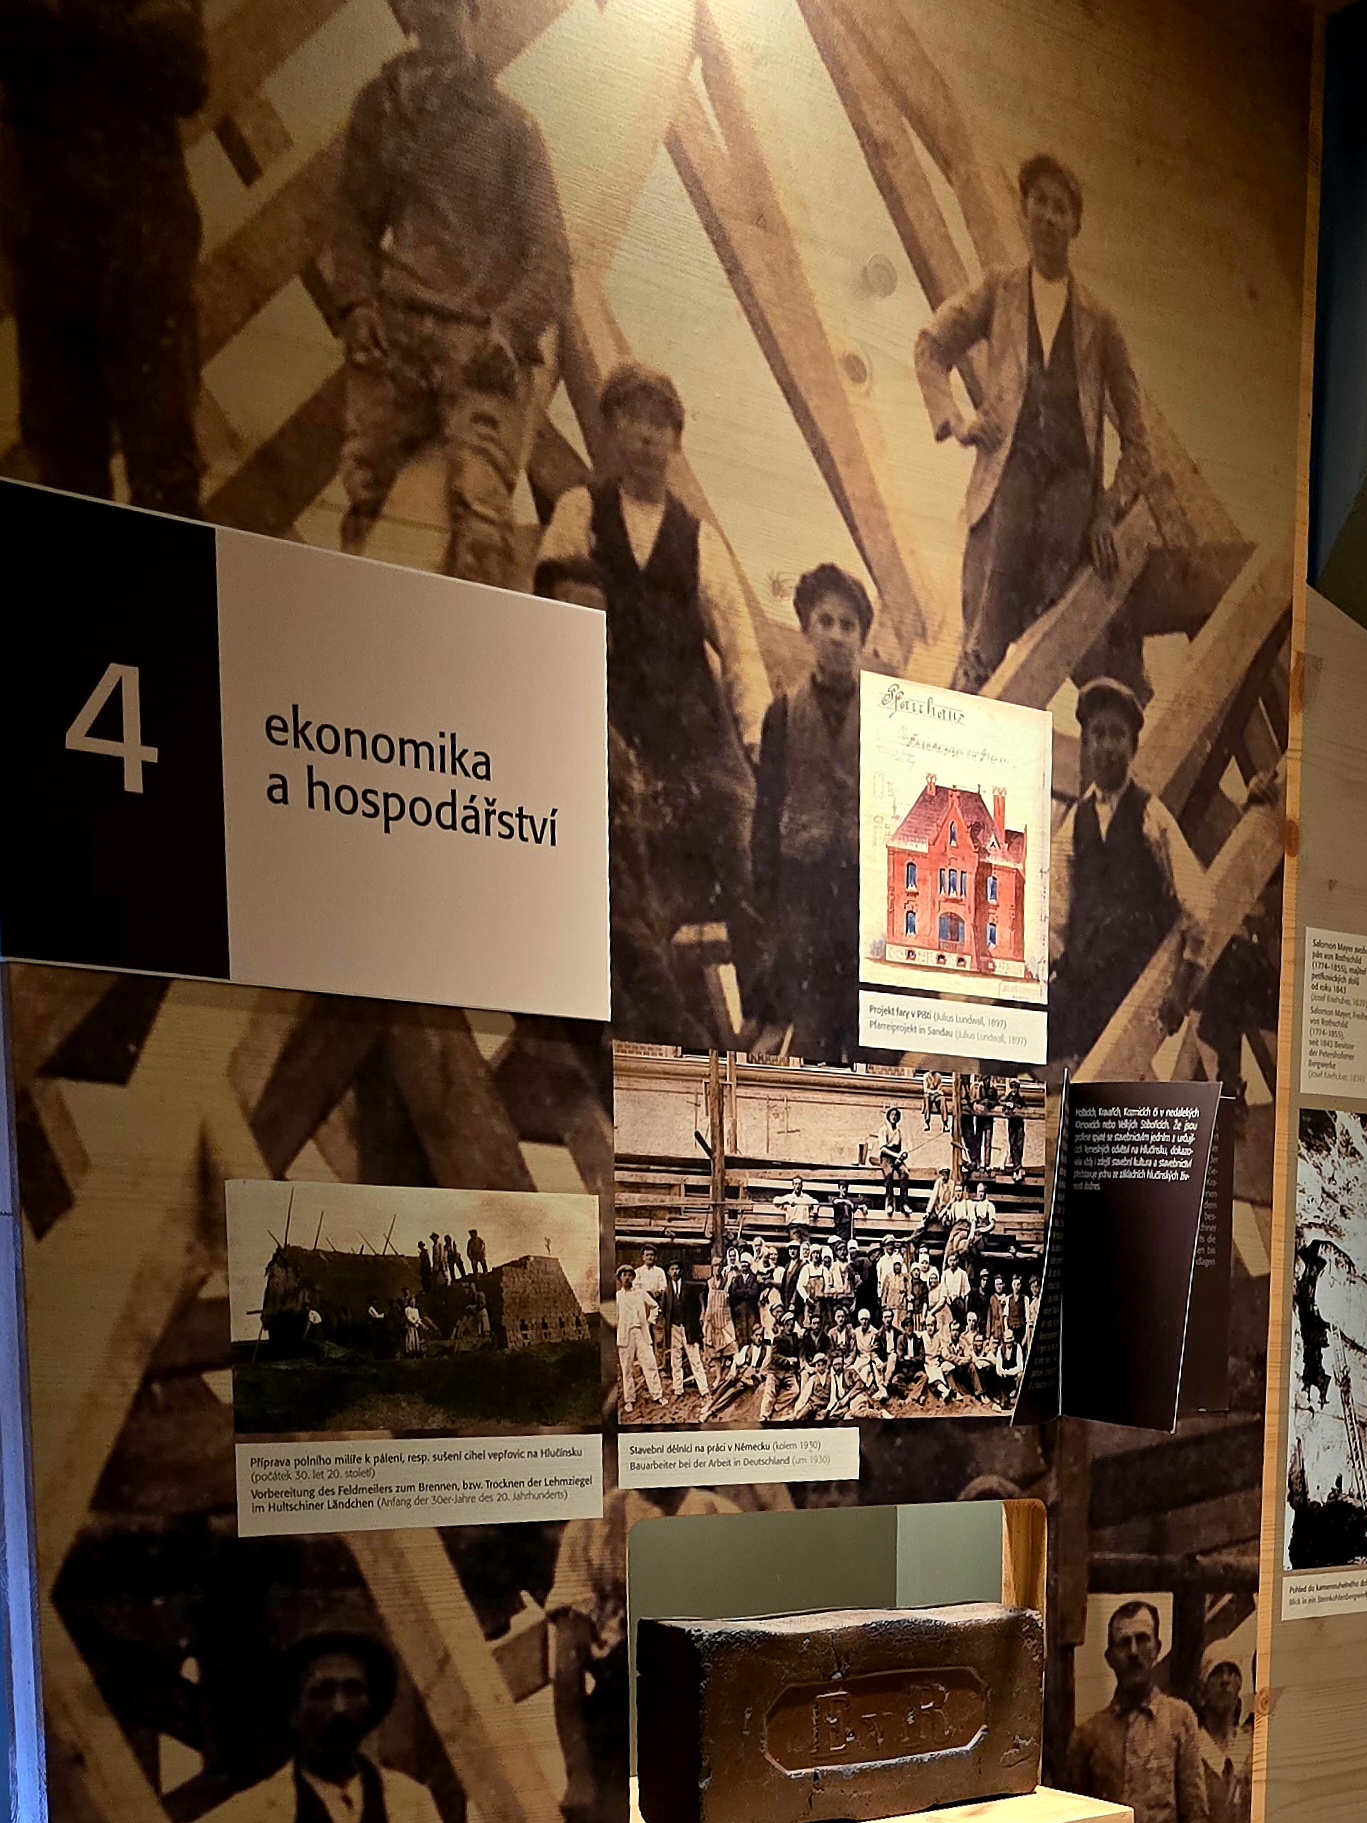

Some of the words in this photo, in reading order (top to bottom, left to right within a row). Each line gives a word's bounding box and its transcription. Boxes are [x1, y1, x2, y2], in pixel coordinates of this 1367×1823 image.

[65, 663, 158, 793] 4
[265, 705, 491, 781] ekonomika
[267, 771, 289, 805] a
[307, 765, 558, 846] hospodářství
[869, 1005, 894, 1016] Projekt
[896, 1007, 909, 1019] fary
[919, 1025, 926, 1034] in
[927, 1026, 953, 1037] Sandau
[630, 1445, 664, 1455] Stavební
[707, 1443, 725, 1455] práci
[735, 1442, 770, 1451] Německu
[251, 1458, 290, 1470] Příprava
[294, 1455, 331, 1469] polního
[408, 1455, 429, 1464] resp.
[433, 1451, 462, 1462] sušení
[465, 1450, 485, 1460] cihel
[630, 1460, 676, 1470] Bauarbeiter
[679, 1459, 691, 1469] bei
[693, 1459, 706, 1468] der
[708, 1458, 731, 1467] Arbeit
[734, 1458, 741, 1466] in
[743, 1456, 790, 1466] Deutschland
[313, 1469, 324, 1480] let
[328, 1469, 342, 1479] 20.
[251, 1487, 315, 1499] Vorbereitung
[318, 1486, 335, 1496] des
[338, 1484, 393, 1496] Feldmeilers
[396, 1485, 416, 1493] zum
[419, 1483, 460, 1492] Brennen,
[486, 1479, 524, 1489] Trocknen
[528, 1478, 541, 1487] der
[545, 1475, 592, 1487] Lehmziegel
[269, 1500, 324, 1512] Hultschiner
[328, 1498, 374, 1509] Ländchen
[377, 1496, 412, 1510] (Anfang
[414, 1495, 428, 1505] der
[479, 1492, 494, 1503] des
[497, 1493, 510, 1502] 20.
